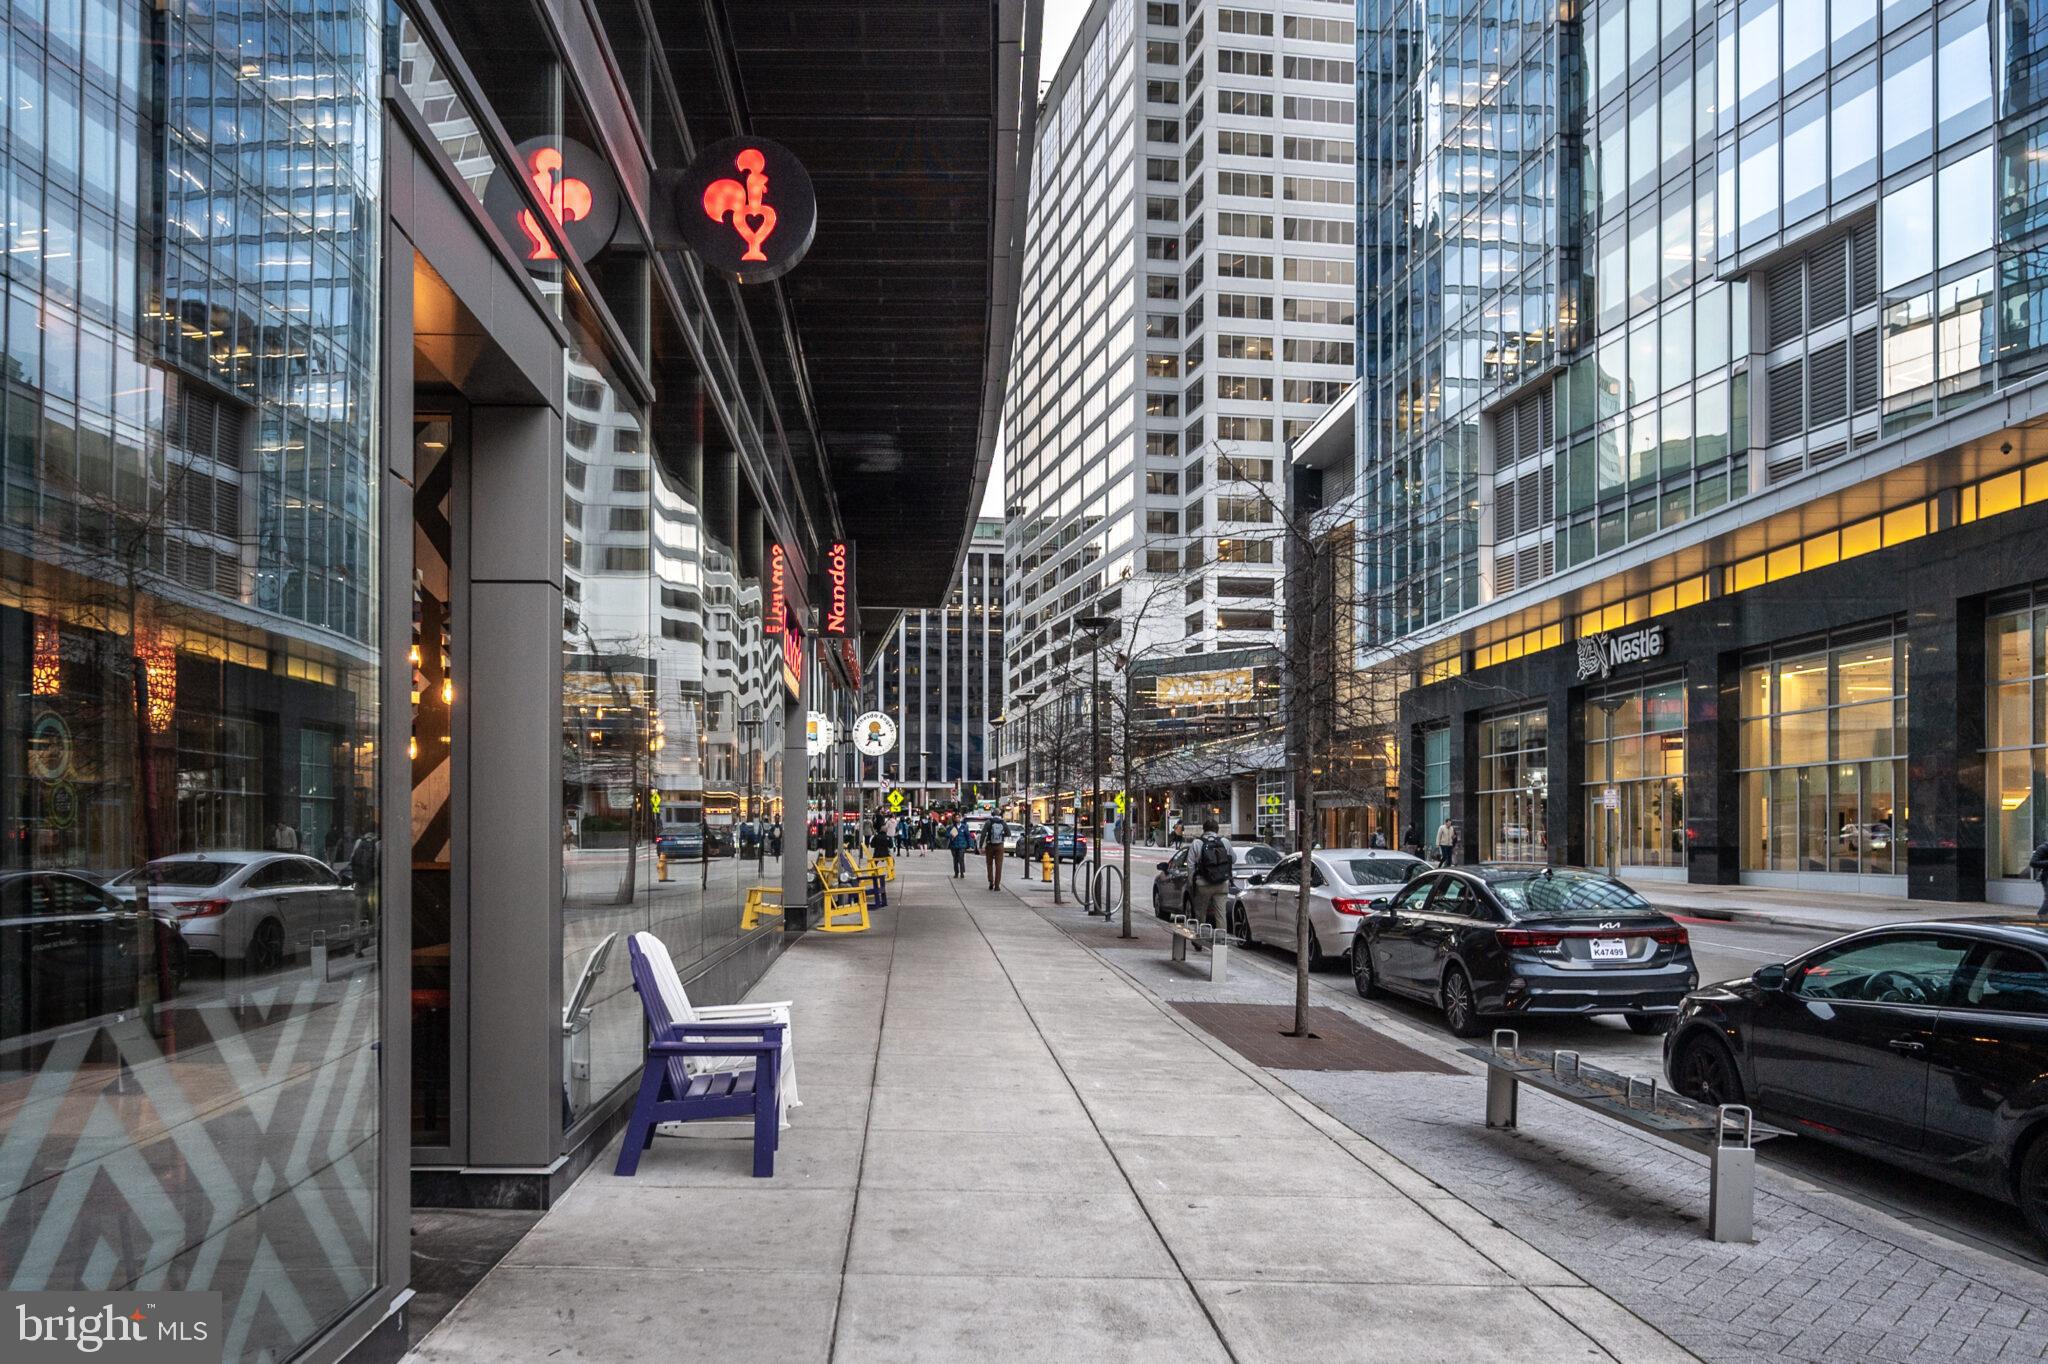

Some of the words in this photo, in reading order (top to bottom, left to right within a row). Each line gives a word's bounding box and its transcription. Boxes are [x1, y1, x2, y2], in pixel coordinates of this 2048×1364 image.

[828, 543, 847, 634] Nando's
[1610, 625, 1661, 666] Nestlé
[1594, 947, 1624, 957] K47499
